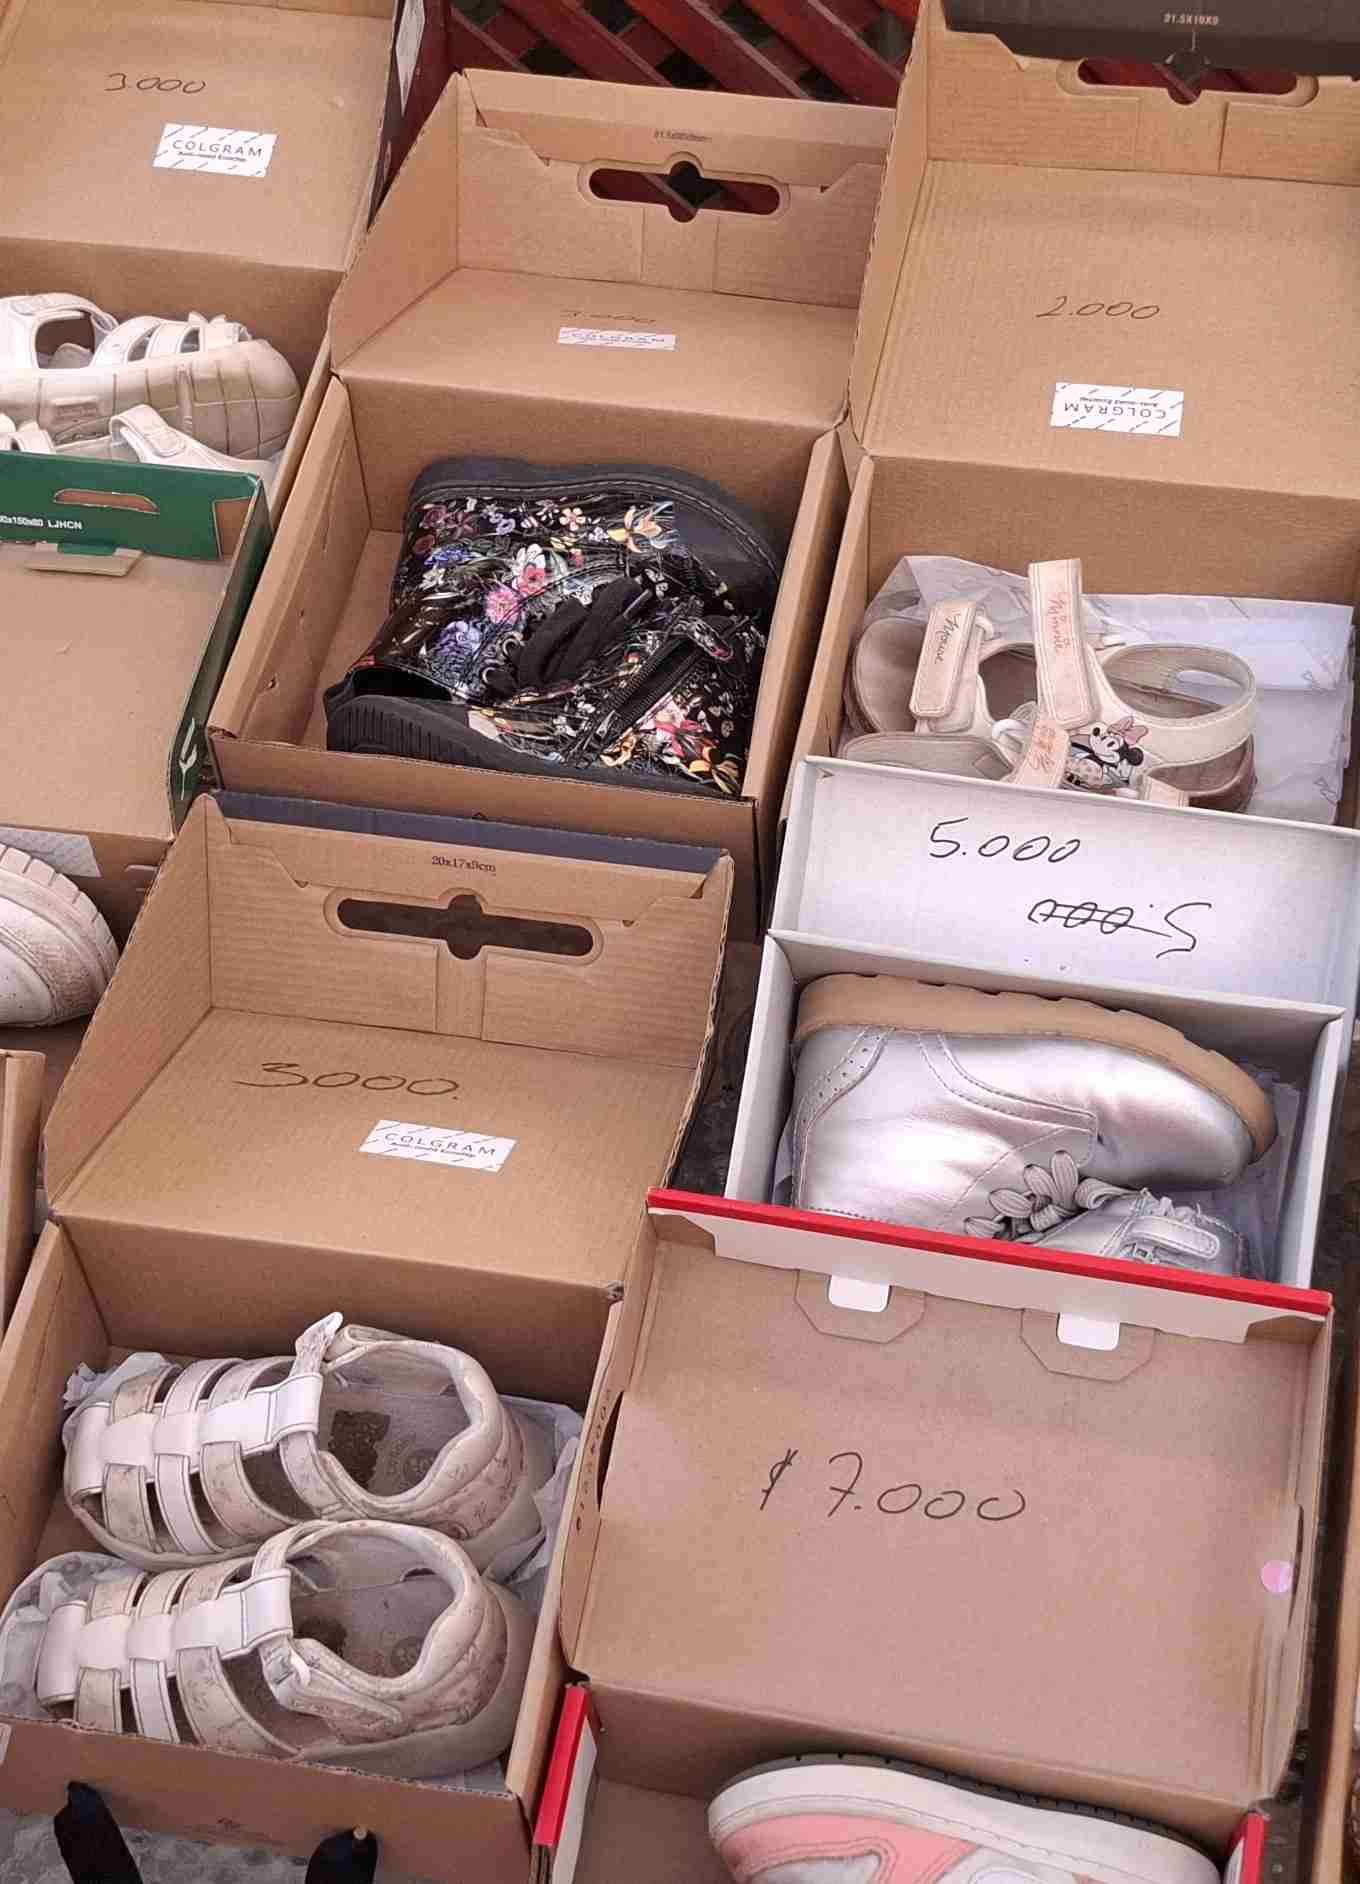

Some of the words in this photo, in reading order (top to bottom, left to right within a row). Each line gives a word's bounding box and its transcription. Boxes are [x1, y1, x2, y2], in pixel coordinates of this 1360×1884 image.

[171, 138, 264, 159] COLGRAM
[1035, 295, 1161, 320] 2.000
[929, 816, 1081, 863] 5.000
[384, 1132, 496, 1156] COLGRAM
[826, 1451, 1026, 1521] 7.000
